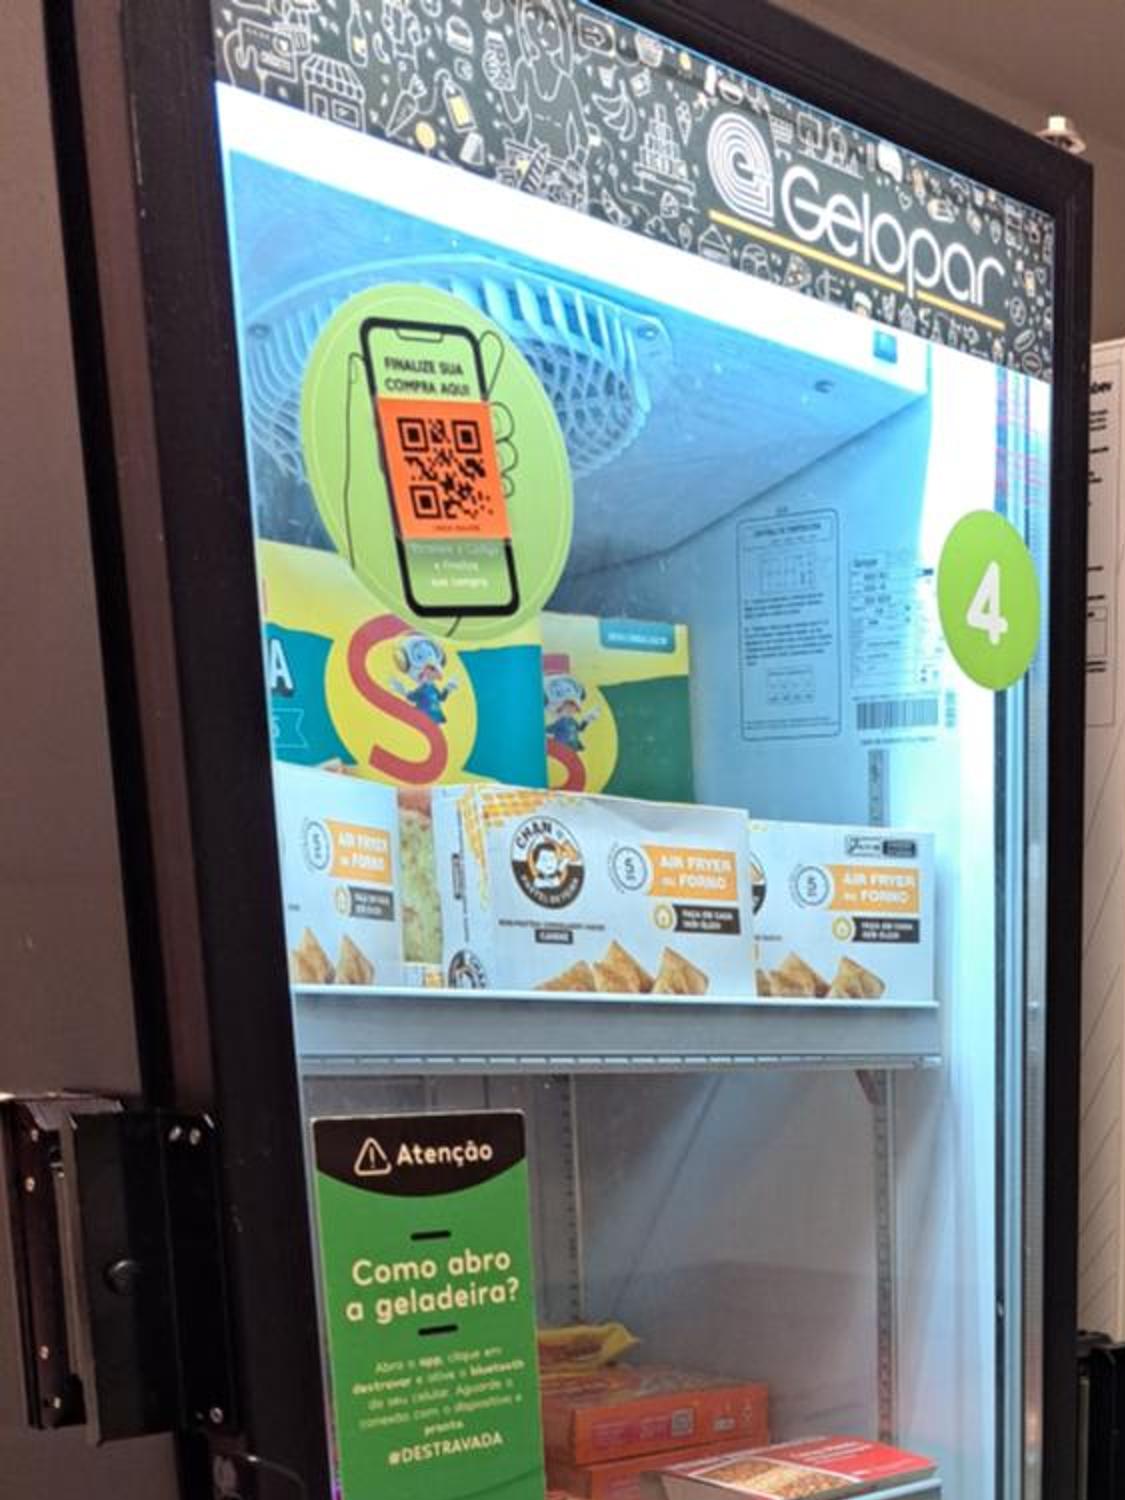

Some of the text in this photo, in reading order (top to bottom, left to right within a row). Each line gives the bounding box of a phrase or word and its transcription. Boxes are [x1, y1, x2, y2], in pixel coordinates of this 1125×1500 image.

[781, 164, 1006, 307] Gelopar
[384, 357, 463, 376] FINALIZE SUA
[385, 378, 471, 396] COMPRA AQUI
[966, 560, 1009, 645] 4
[623, 857, 635, 875] 5
[660, 855, 732, 872] AIR FRYER
[679, 875, 727, 890] FORNO
[805, 876, 818, 894] 5
[843, 873, 915, 888] AIR FRYER
[860, 890, 909, 904] FORNO
[397, 1139, 493, 1168] Atenção
[351, 1248, 512, 1287] Como abro
[345, 1276, 520, 1326] a geladeira?
[388, 1431, 504, 1467] #DESTRAVADA
